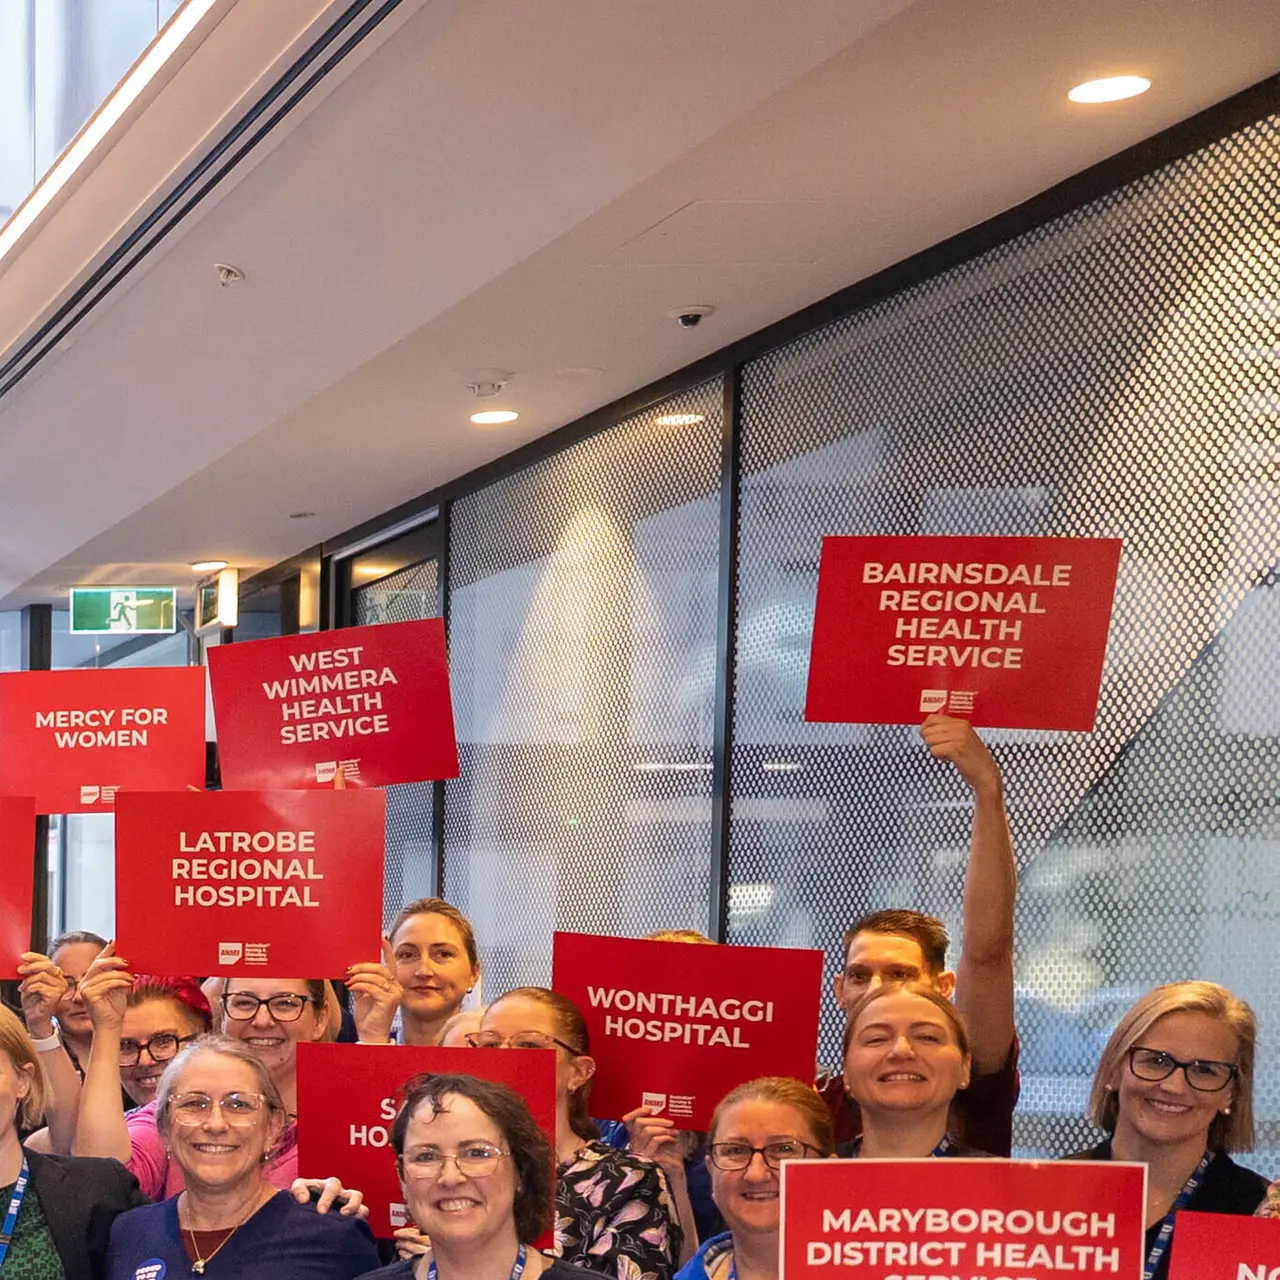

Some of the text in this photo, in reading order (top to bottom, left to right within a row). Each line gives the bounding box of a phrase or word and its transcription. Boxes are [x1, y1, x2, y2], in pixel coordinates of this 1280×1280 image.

[862, 562, 1073, 587] BAIRNSDALE
[879, 590, 1047, 614] REGIONAL
[895, 617, 1023, 642] HEALTH
[288, 646, 364, 673] WEST
[886, 644, 1024, 669] SERVICE
[261, 666, 398, 700] WIMMERA
[35, 707, 168, 729] MERCY FOR
[281, 691, 383, 722] HEALTH
[54, 729, 148, 749] WOMEN
[280, 714, 390, 745] SERVICE
[179, 830, 316, 853] LATROBE
[172, 858, 324, 880] REGIONAL
[175, 885, 320, 907] HOSPITAL
[587, 985, 774, 1023] WONTHAGGI
[605, 1015, 750, 1049] HOSPITAL
[822, 1208, 1116, 1238] MARYBOROUGH
[806, 1241, 1120, 1273] DISTRICT HEALTH
